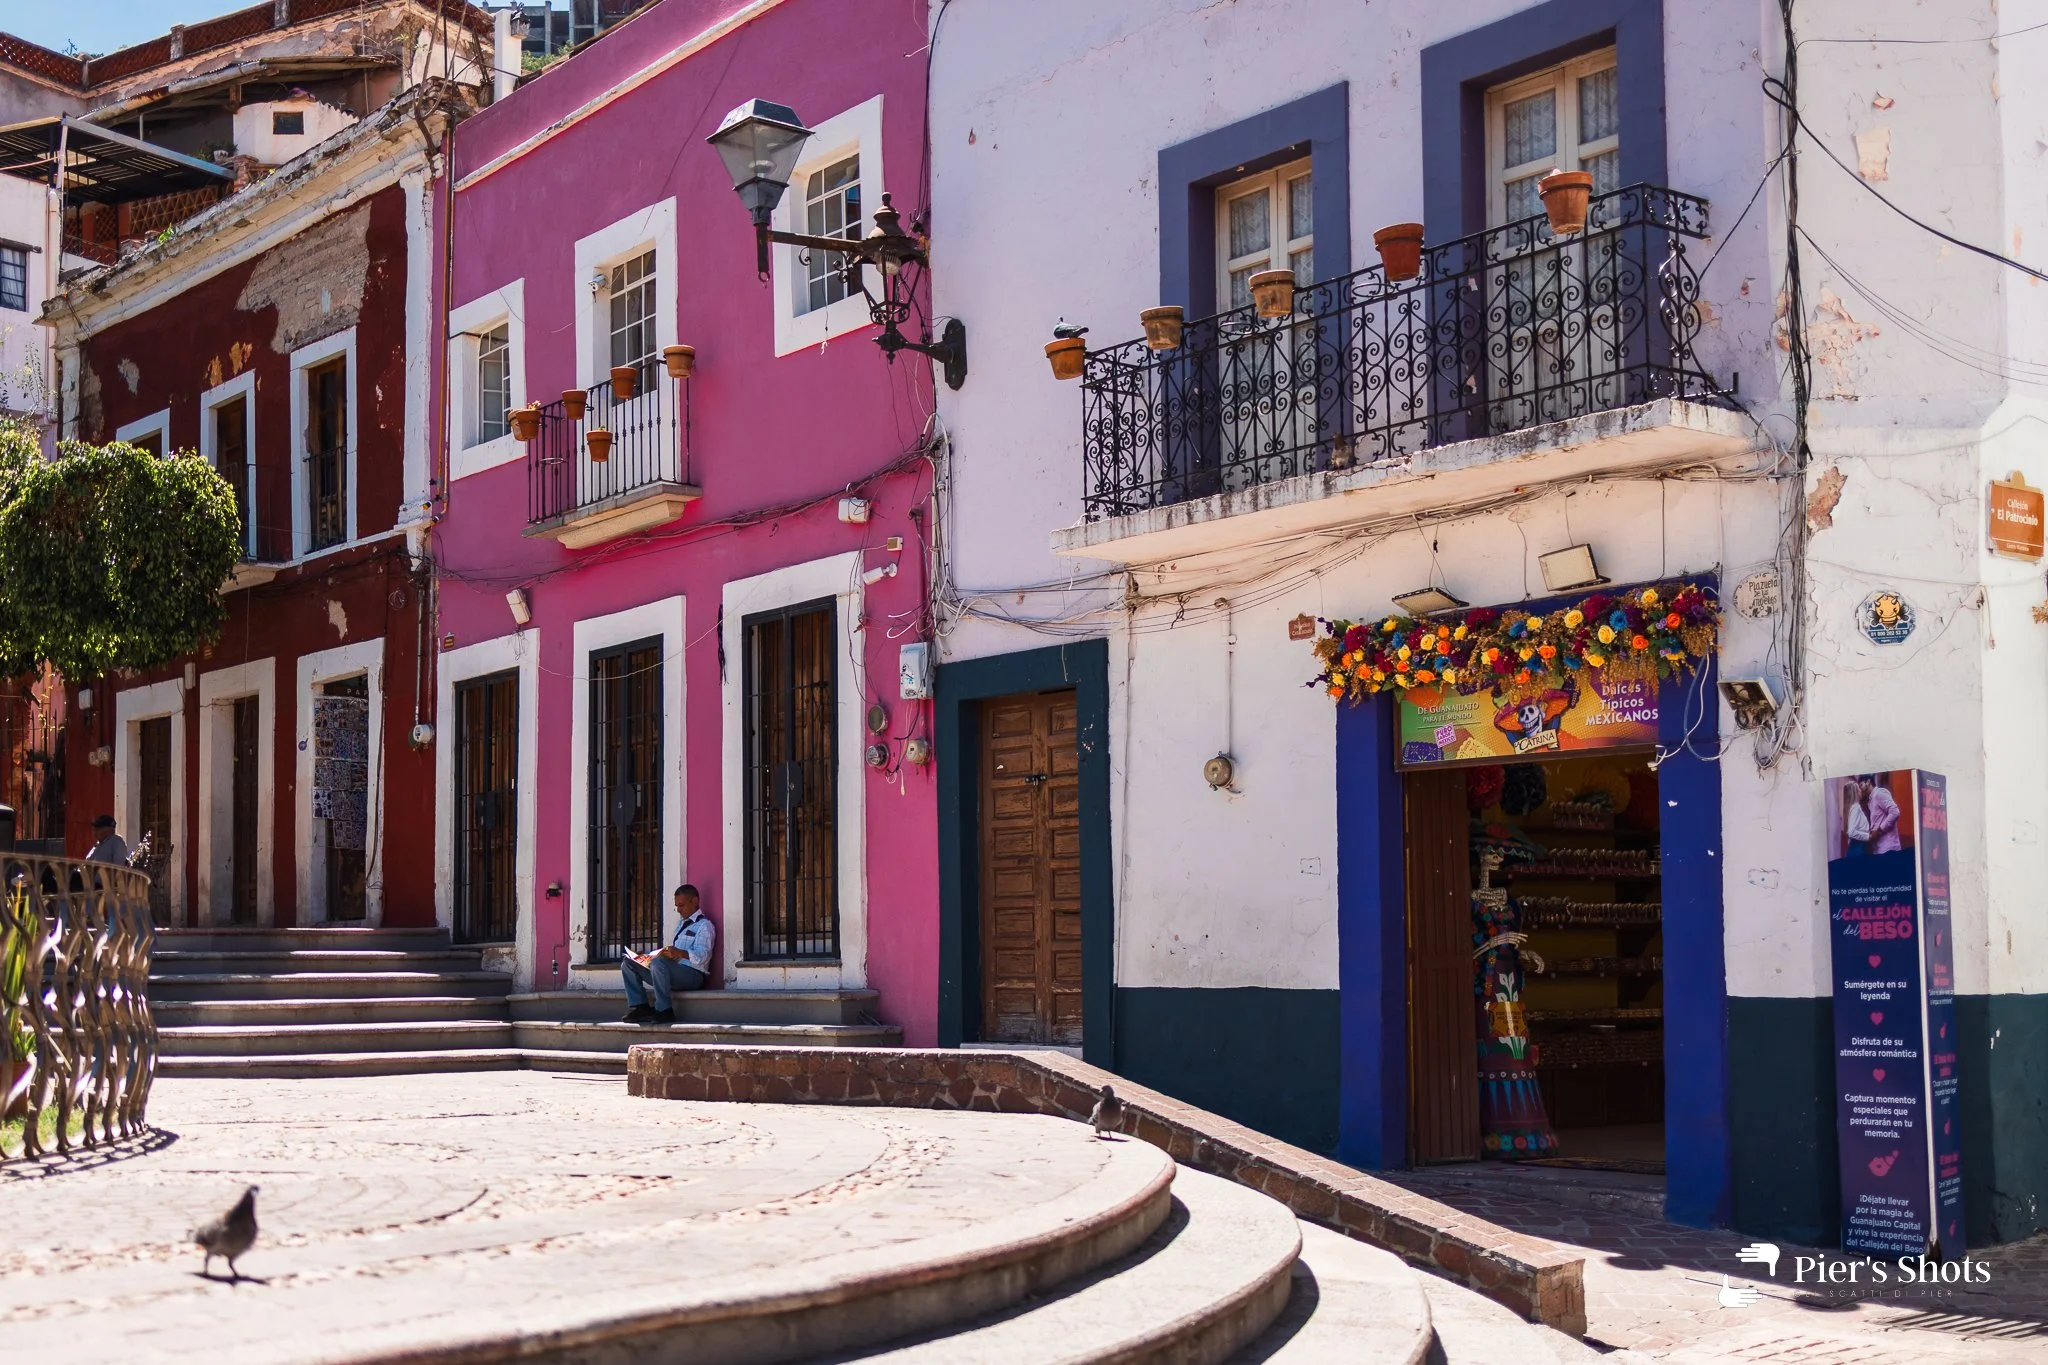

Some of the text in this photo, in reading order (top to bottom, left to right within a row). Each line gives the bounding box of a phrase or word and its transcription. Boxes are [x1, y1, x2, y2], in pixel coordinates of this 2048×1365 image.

[1997, 508, 2039, 526] El Patrocinio
[1417, 702, 1480, 715] DE GUANAJUATO
[1600, 697, 1645, 712] Típicos
[1447, 713, 1473, 721] MUNDO
[1585, 709, 1659, 726] MEXICANOS
[1519, 732, 1555, 751] CATRINA
[1876, 885, 1912, 893] oportunidad
[1842, 903, 1912, 920] CALLEJÓN
[1843, 920, 1913, 940] del BESO
[1844, 981, 1885, 990] Sumérgete
[1860, 992, 1891, 1001] leyenda
[1851, 1037, 1881, 1046] Disfruta
[1882, 1038, 1892, 1046] de
[1840, 1049, 1917, 1058] atmósfera romántica
[1844, 1094, 1916, 1104] Captura momentos
[1853, 1106, 1892, 1116] especiales
[1850, 1117, 1891, 1127] perdurarán
[1904, 1119, 1913, 1127] tu
[1864, 1129, 1900, 1138] memoria.
[1887, 1196, 1909, 1206] llevar
[1878, 1208, 1902, 1218] magia
[1903, 1210, 1914, 1218] de
[1849, 1216, 1921, 1231] Guanajuato Capital
[1854, 1228, 1869, 1236] vive
[1871, 1229, 1878, 1237] la
[1879, 1232, 1924, 1243] experiencia
[1846, 1238, 1858, 1246] del
[1859, 1239, 1889, 1250] Callejón
[1890, 1243, 1903, 1251] del
